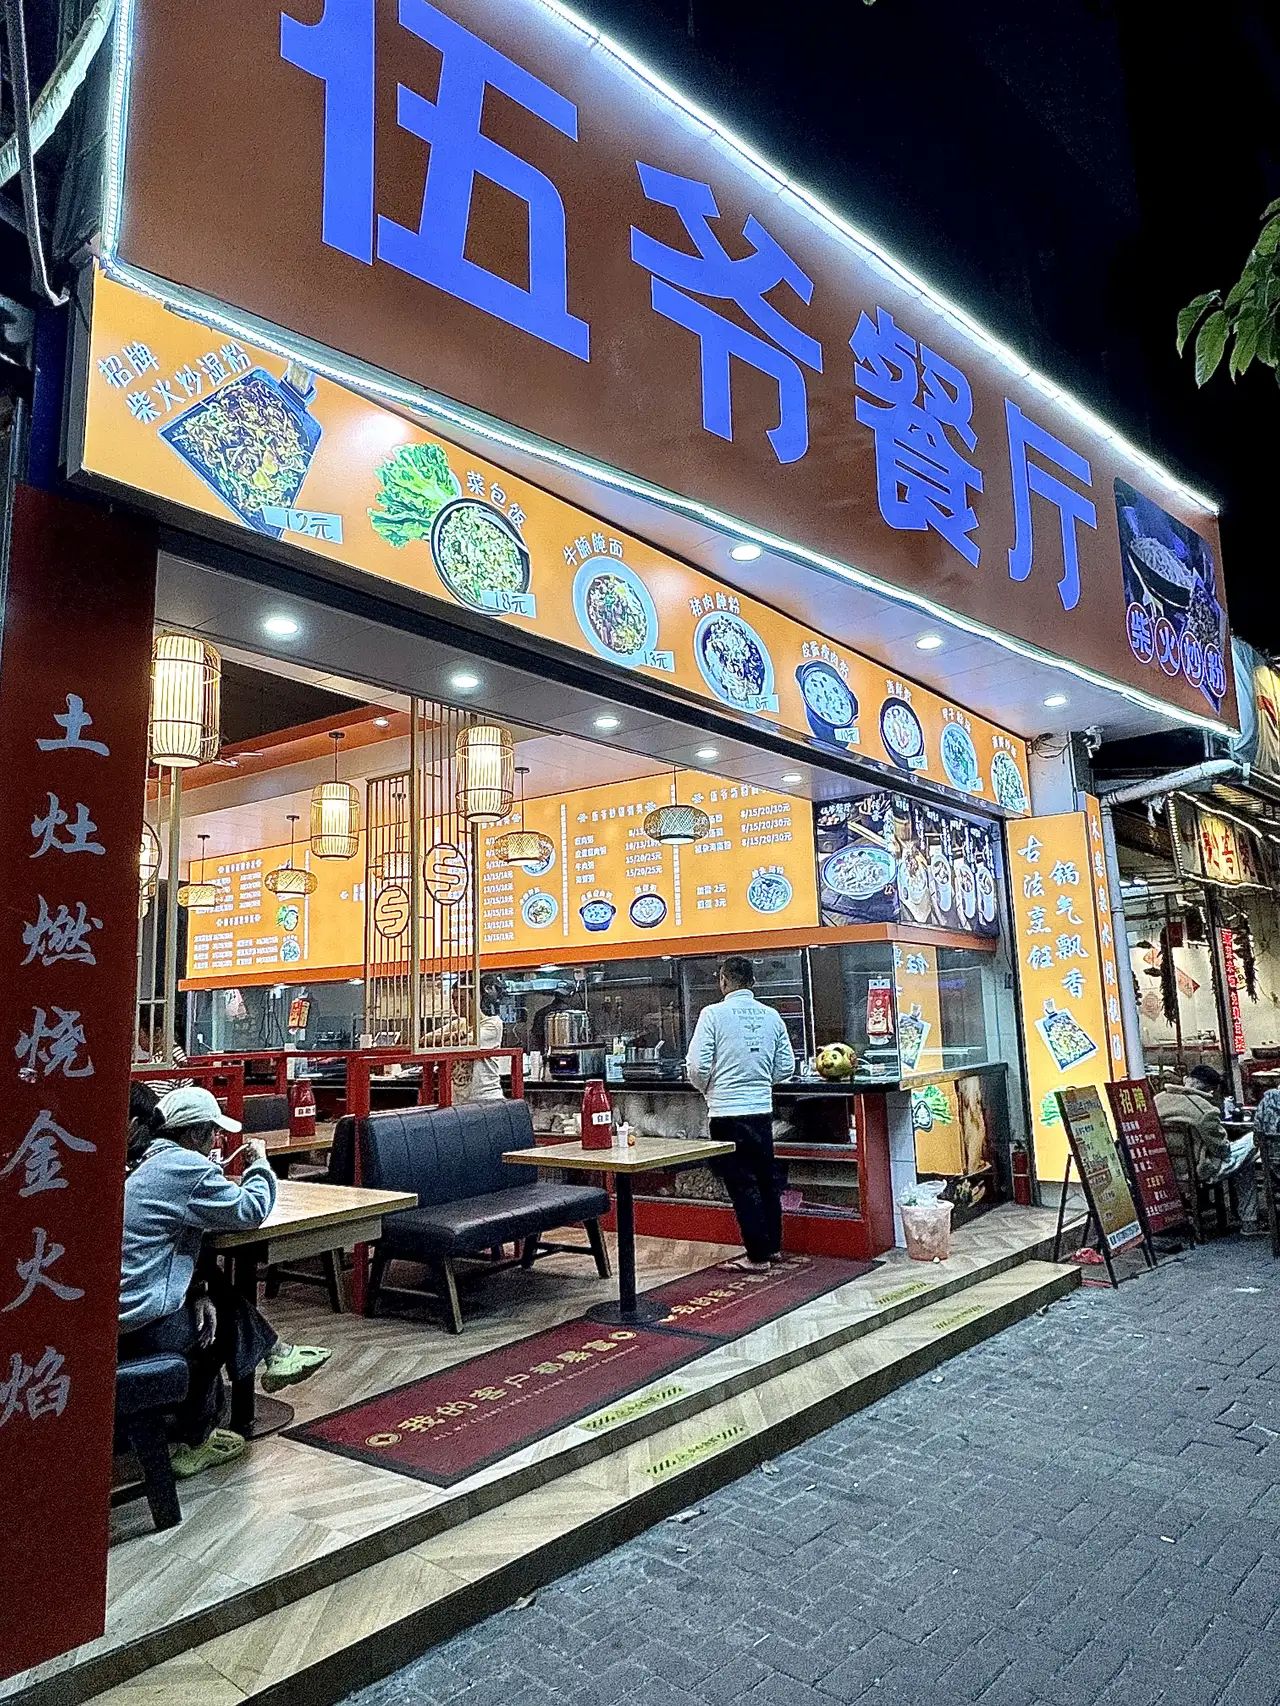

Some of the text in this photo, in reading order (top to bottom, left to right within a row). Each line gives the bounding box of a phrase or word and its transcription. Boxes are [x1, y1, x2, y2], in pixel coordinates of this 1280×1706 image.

[280, 0, 1098, 612] 伍爷餐厅
[97, 341, 159, 388] 招牌
[125, 340, 252, 424] 柴火炒湿粉
[285, 509, 334, 540] 12元
[466, 470, 528, 530] 菜包饭
[494, 590, 528, 614] 18元
[643, 650, 669, 669] 13元
[1017, 835, 1055, 970] 古法烹饪
[1048, 860, 1090, 999] 锅气飘香
[0, 692, 111, 1429] 土灶燃烧金火焰
[1119, 1087, 1148, 1115] 招聘
